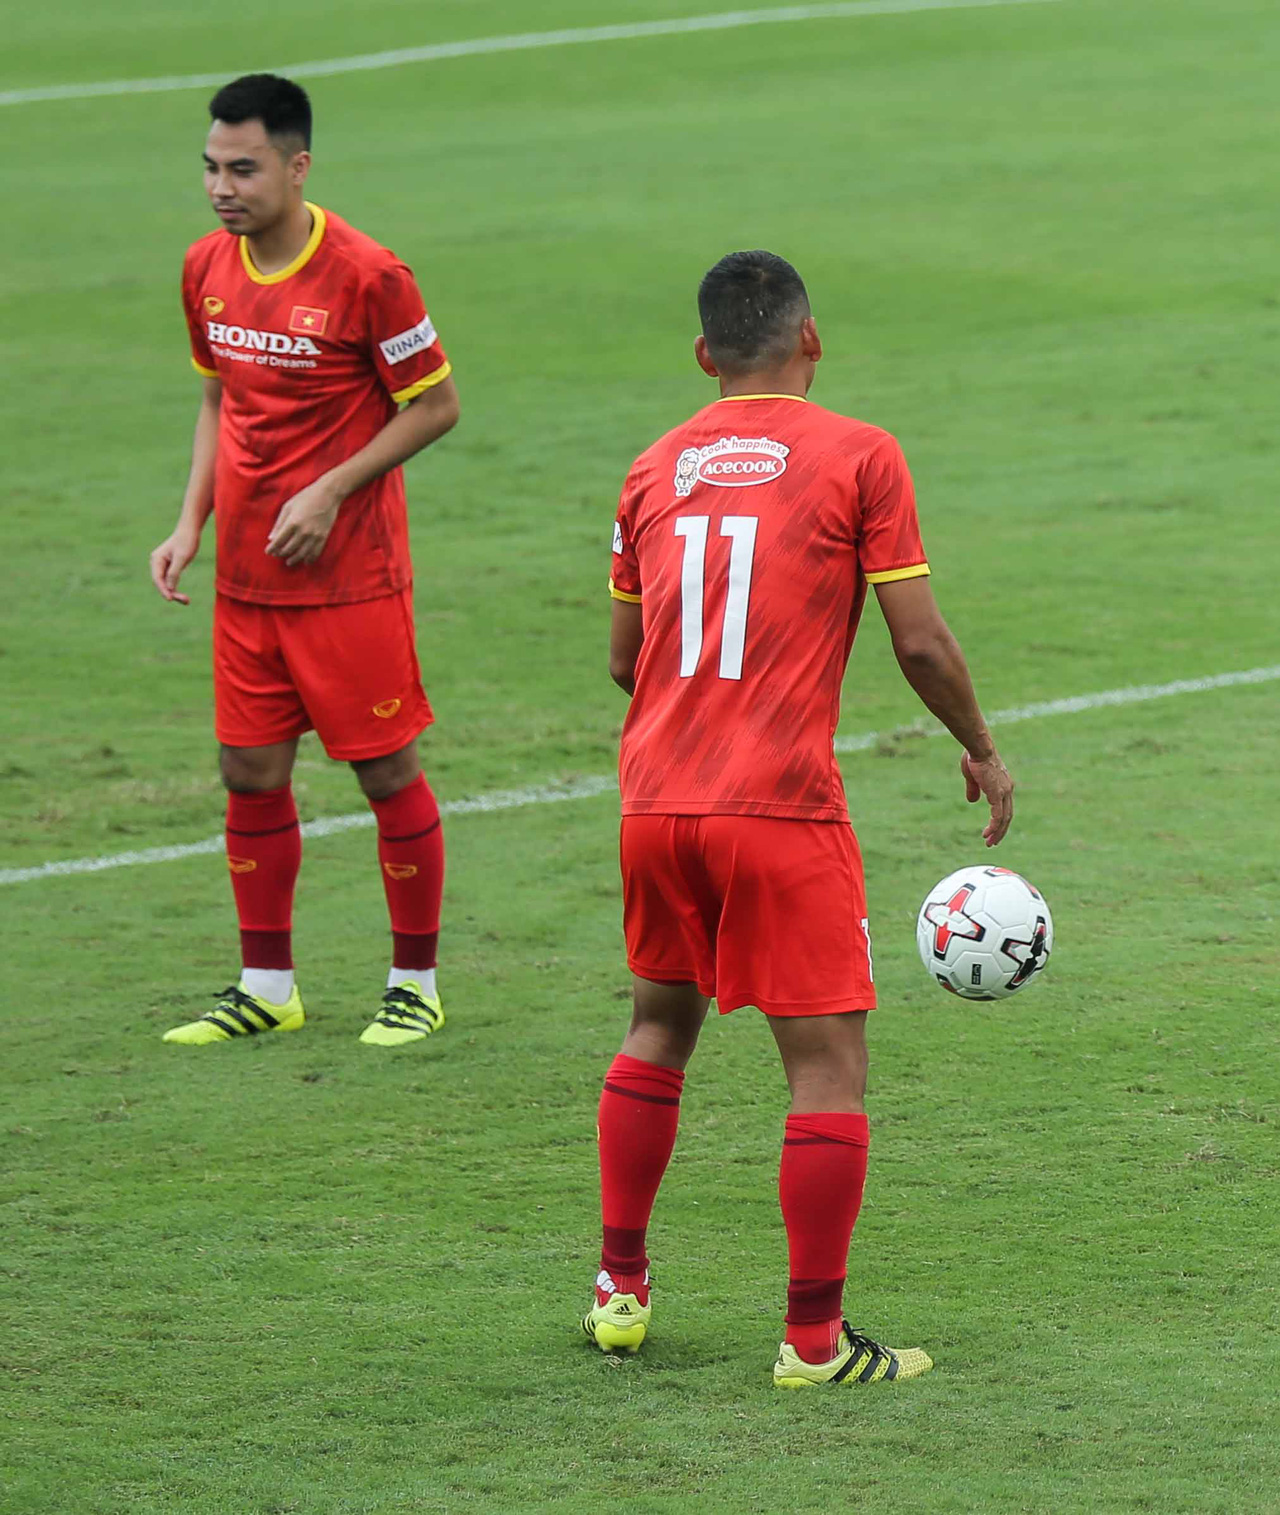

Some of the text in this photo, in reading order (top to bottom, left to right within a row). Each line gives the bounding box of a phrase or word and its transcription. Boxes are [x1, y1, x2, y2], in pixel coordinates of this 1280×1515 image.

[207, 321, 322, 355] HONDA
[227, 348, 255, 363] Power
[256, 355, 268, 365] of
[269, 356, 317, 368] Dreams
[701, 438, 786, 458] Cook happiness
[674, 516, 758, 680] 11
